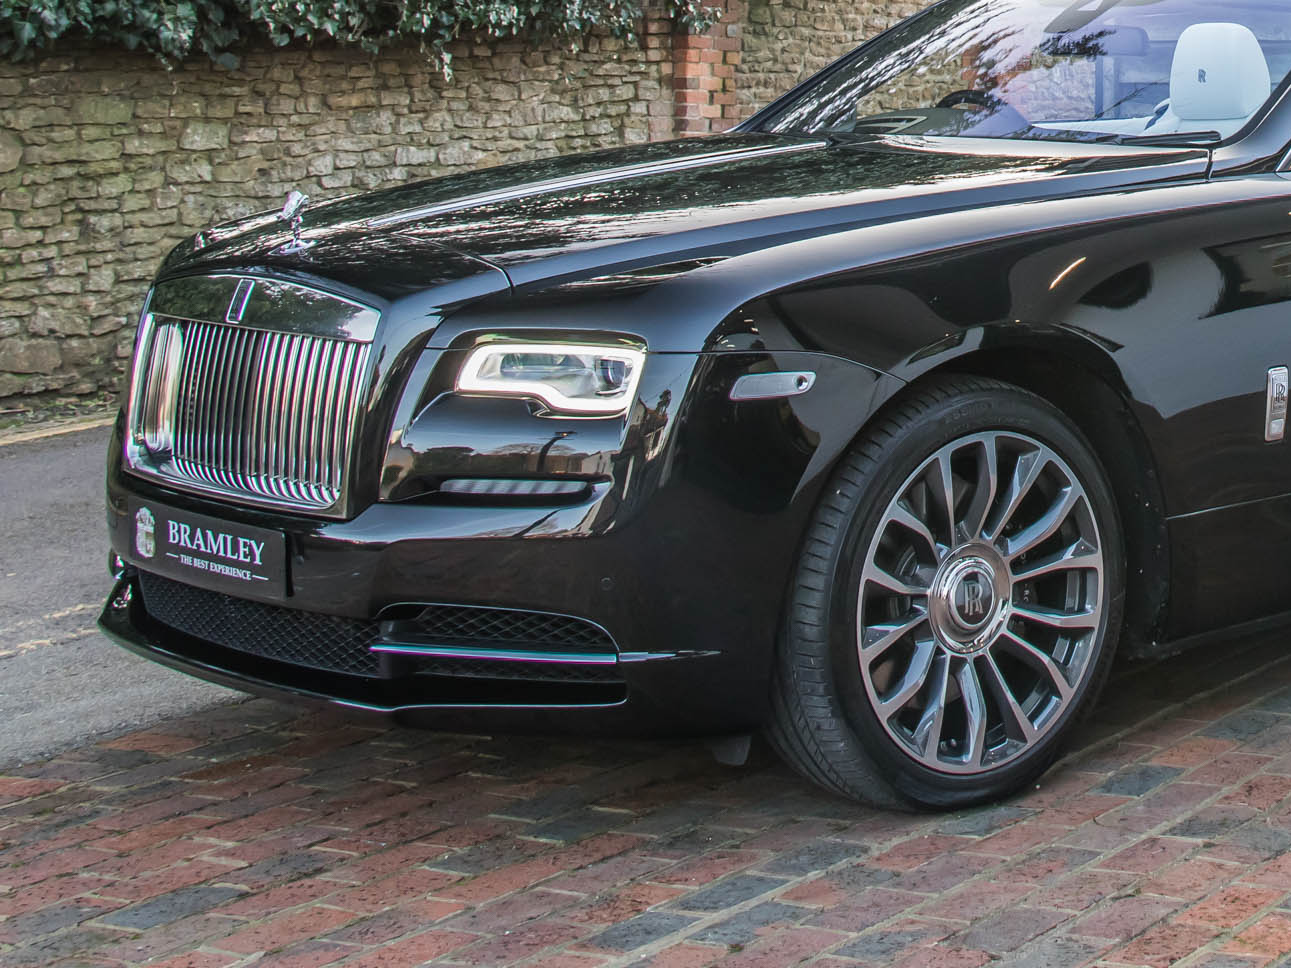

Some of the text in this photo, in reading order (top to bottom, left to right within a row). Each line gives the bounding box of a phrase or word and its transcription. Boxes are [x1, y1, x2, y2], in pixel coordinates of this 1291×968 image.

[168, 519, 265, 565] BRAMLEY
[180, 554, 251, 580] THE BEST EXPERIENCE
